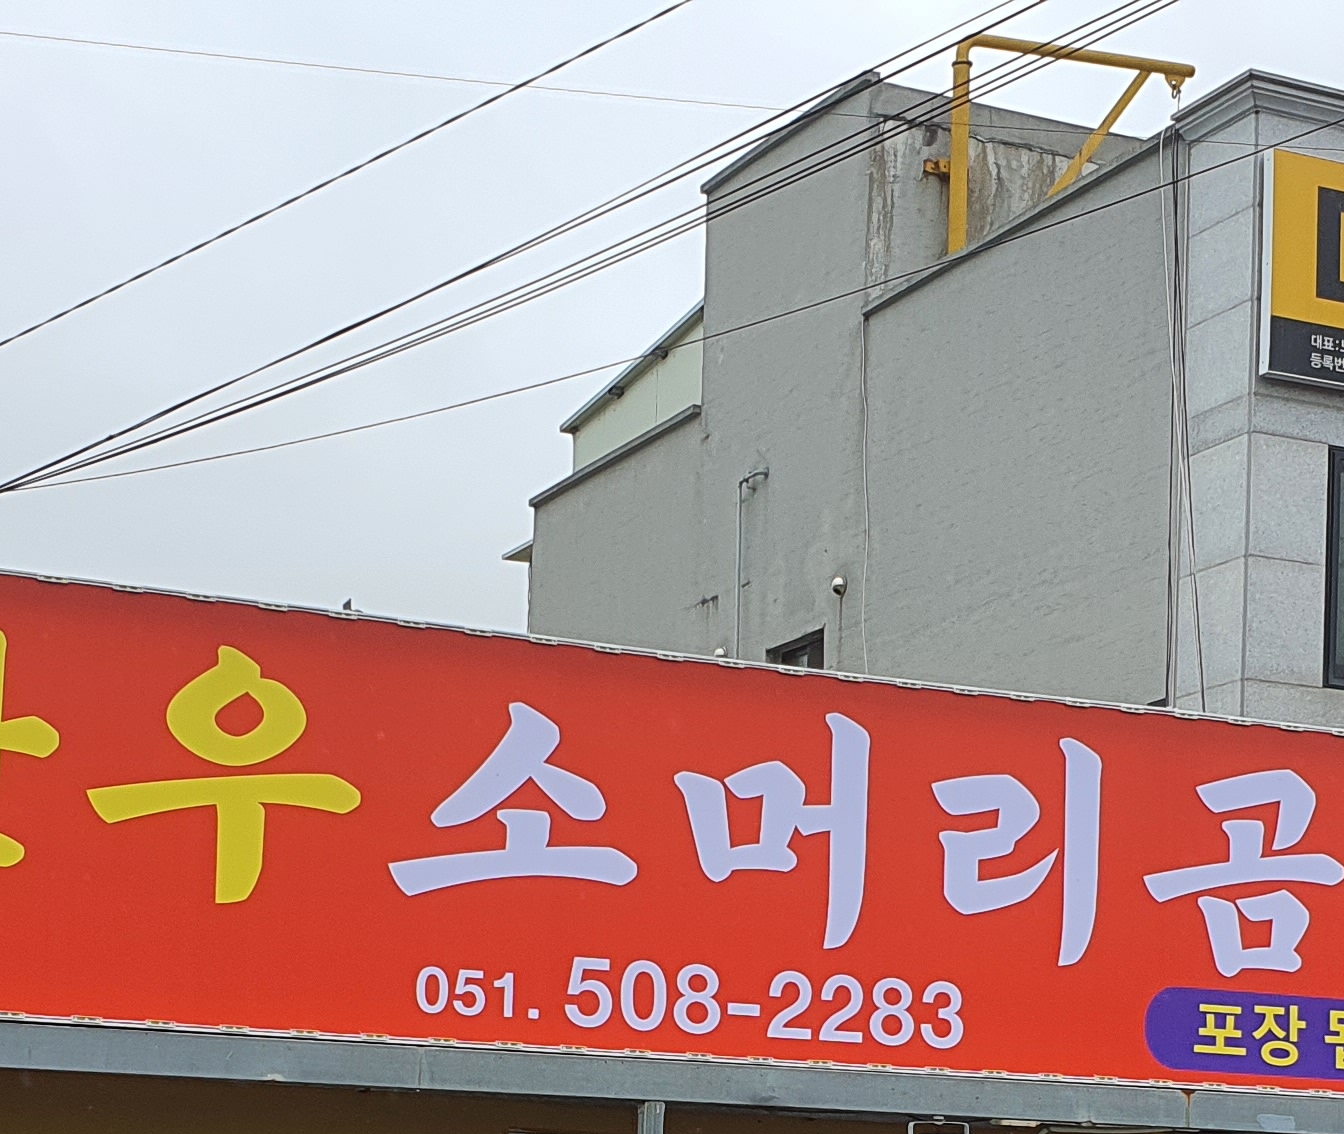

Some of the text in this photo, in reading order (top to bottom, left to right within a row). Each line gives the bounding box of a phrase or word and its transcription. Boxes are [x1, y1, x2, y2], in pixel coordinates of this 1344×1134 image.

[415, 956, 966, 1051] 051. 508-2283
[1193, 1001, 1307, 1065] 포장
